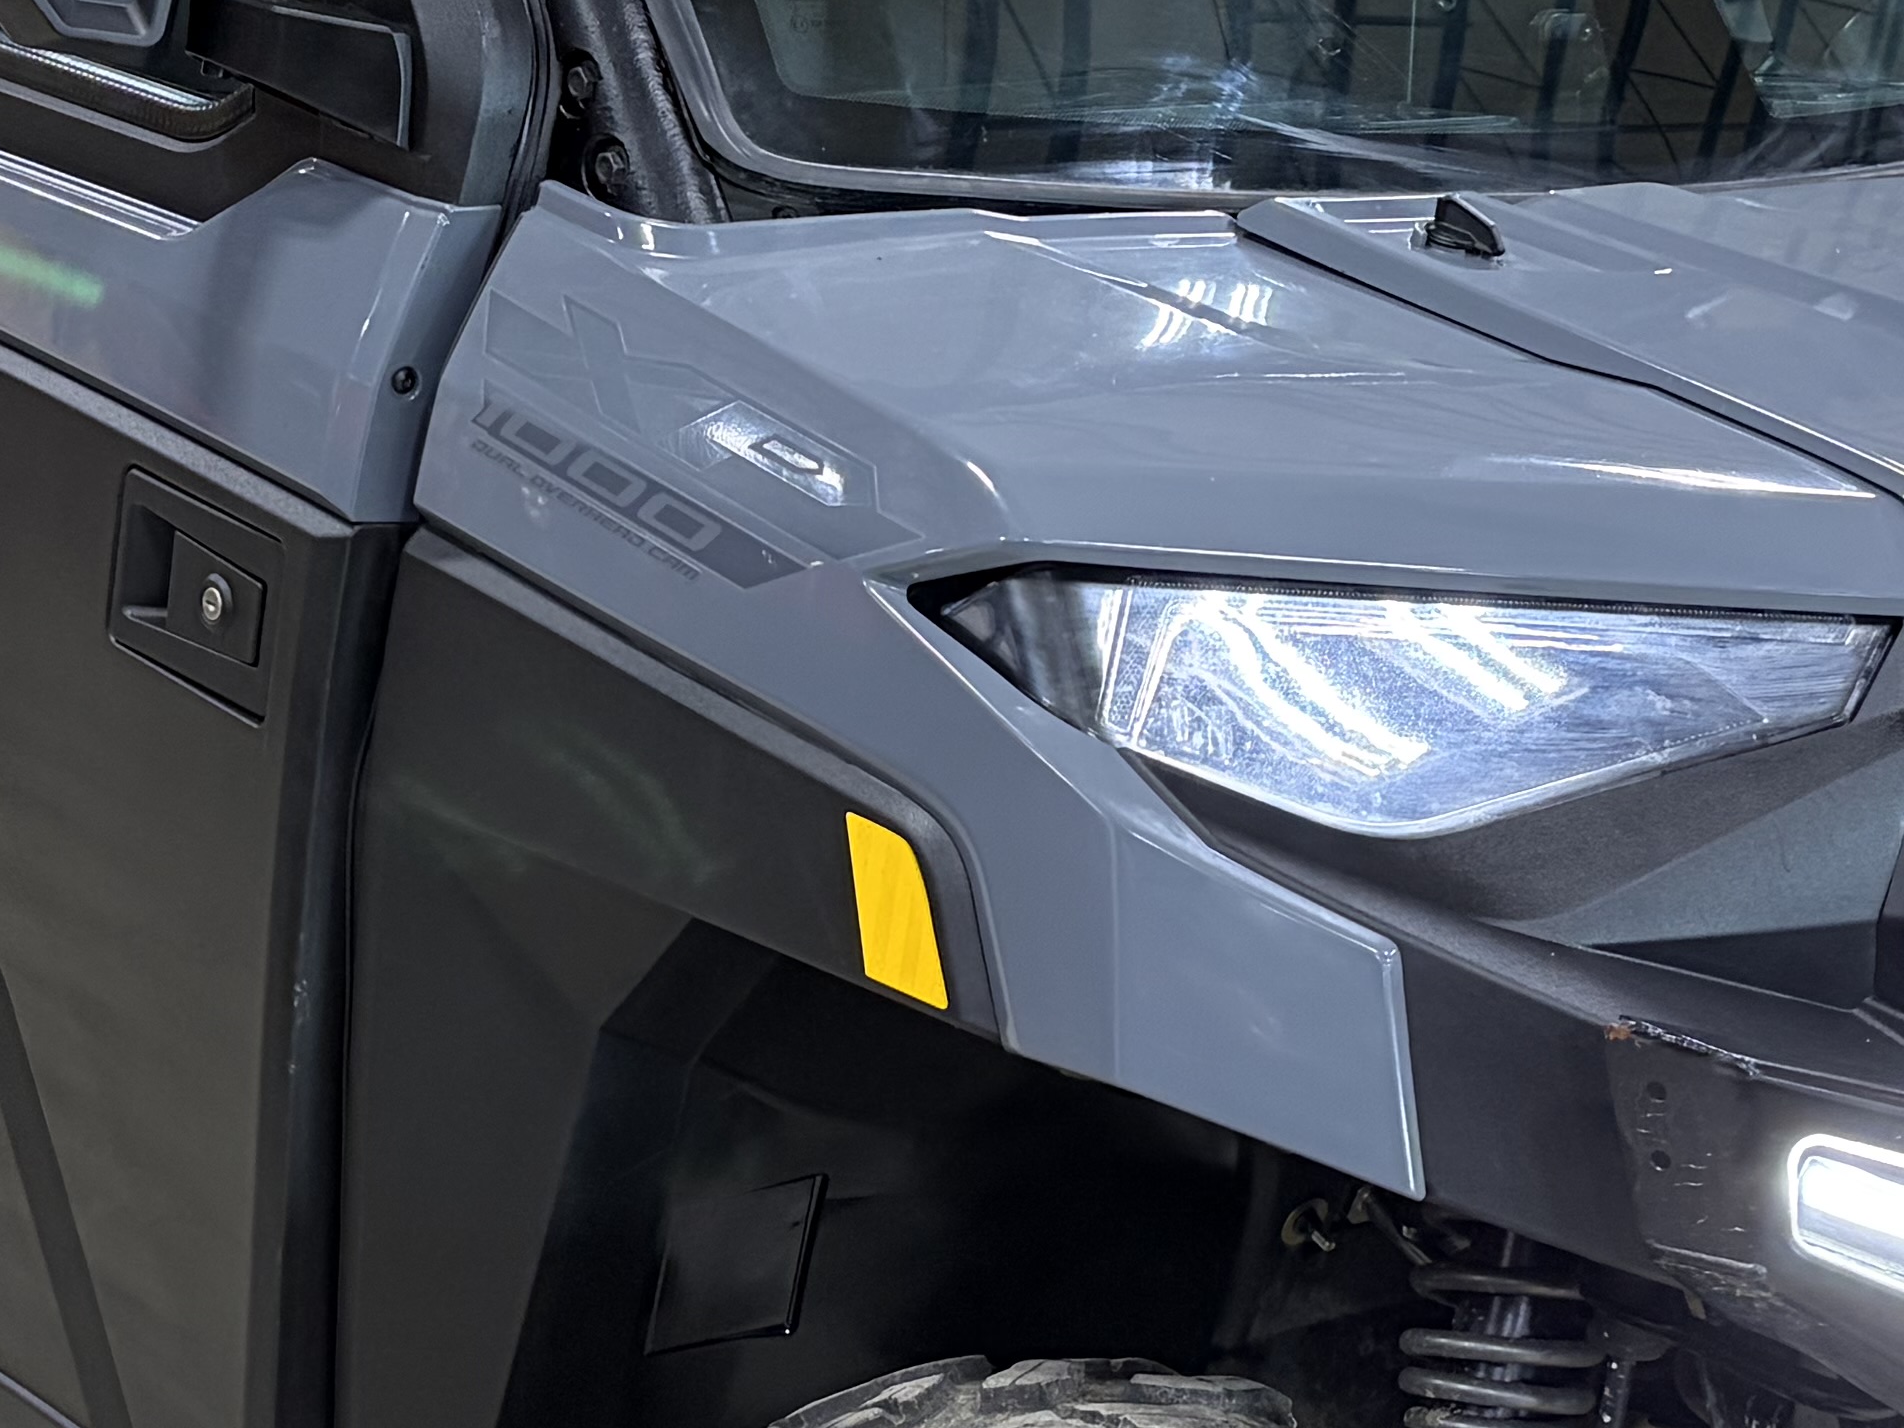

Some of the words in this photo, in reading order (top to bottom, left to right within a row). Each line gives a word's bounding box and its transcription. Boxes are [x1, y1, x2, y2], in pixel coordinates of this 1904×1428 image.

[470, 438, 528, 479] DUAL
[528, 474, 646, 549] OVERHEAD
[471, 398, 722, 553] 1000
